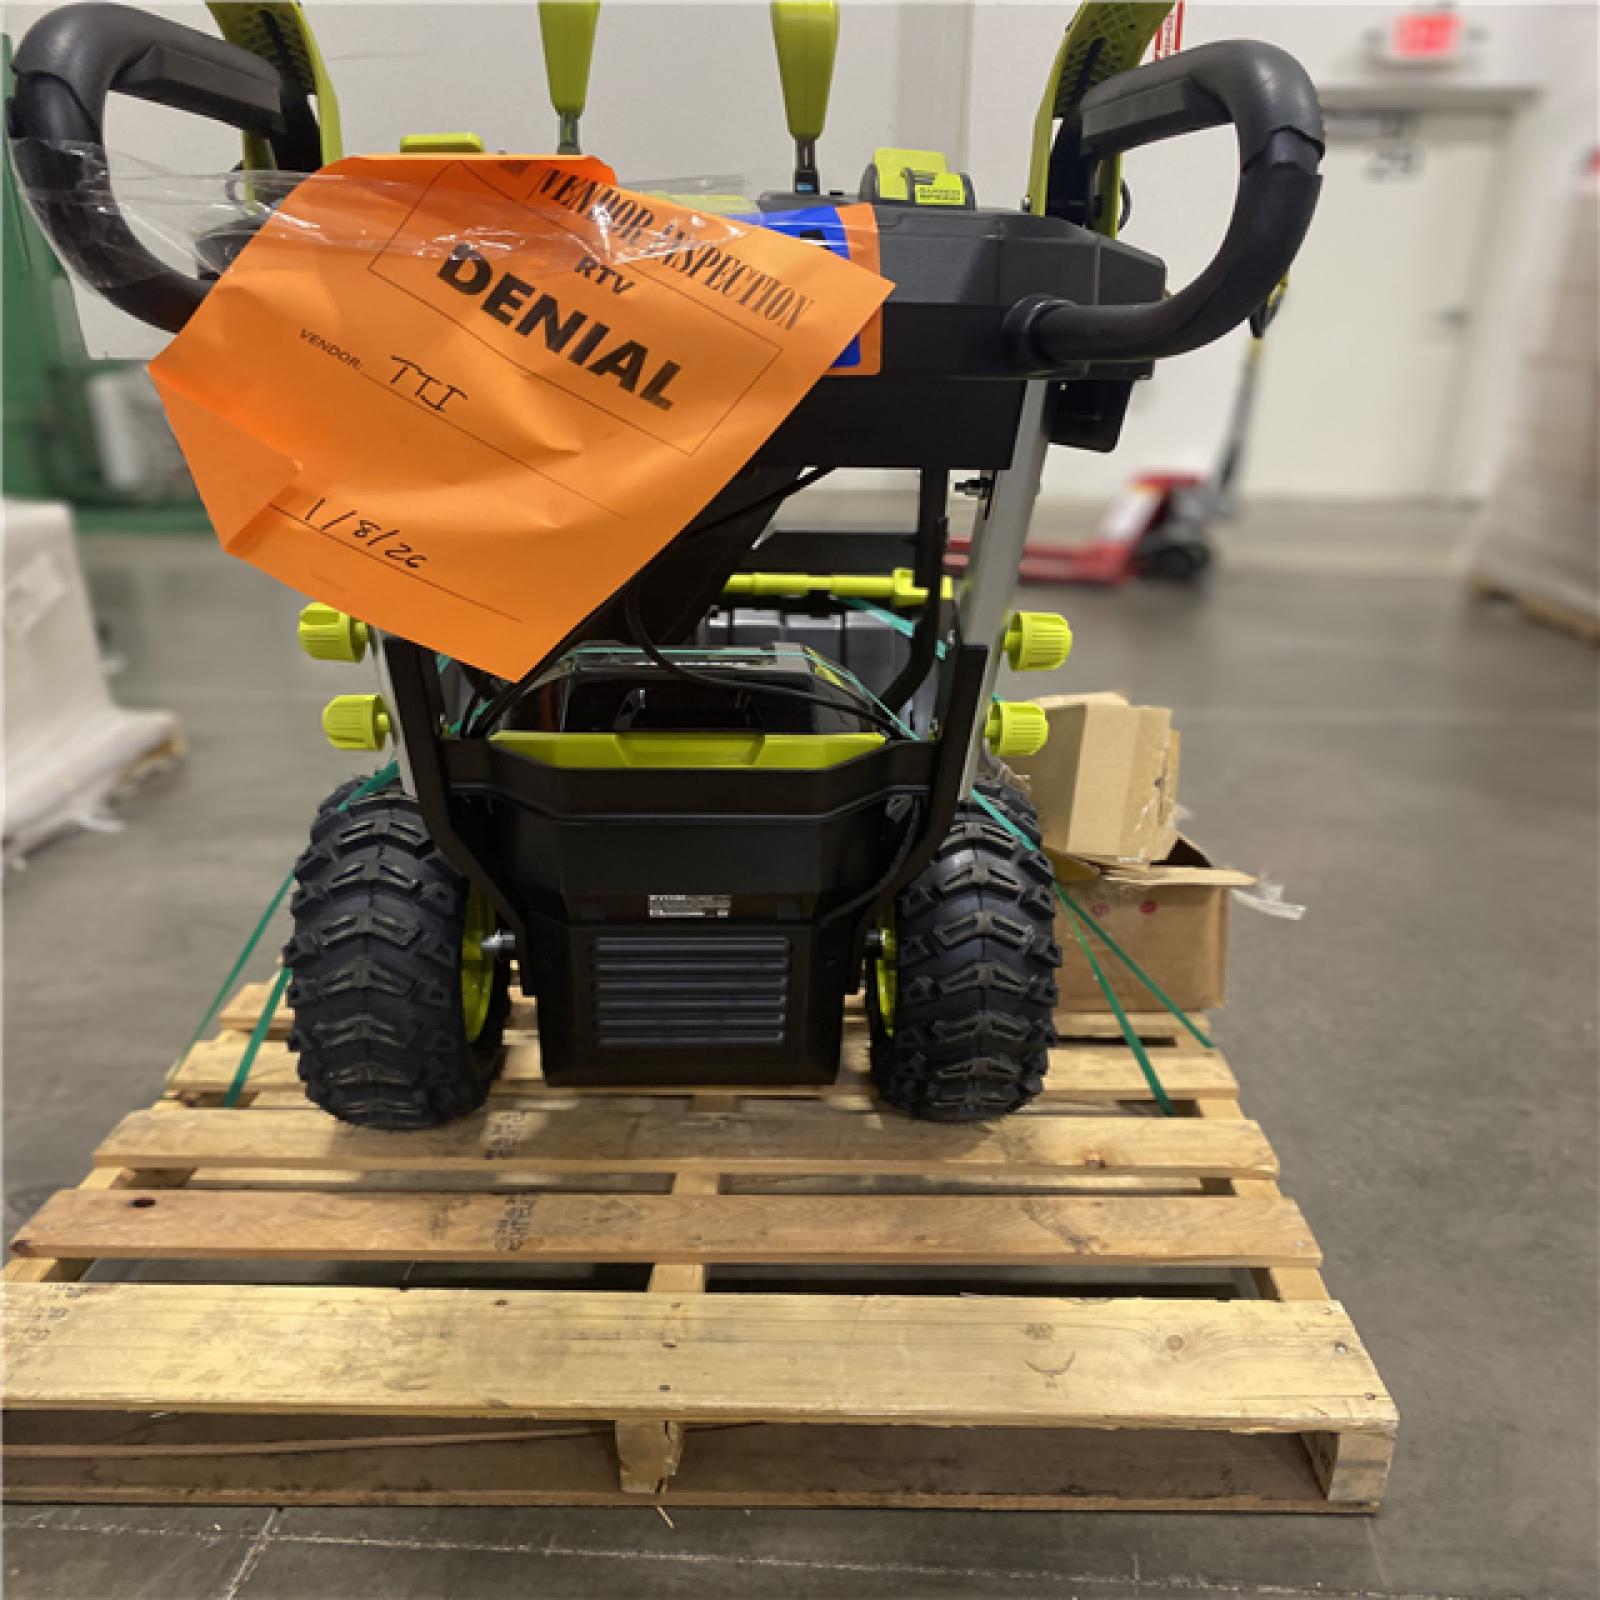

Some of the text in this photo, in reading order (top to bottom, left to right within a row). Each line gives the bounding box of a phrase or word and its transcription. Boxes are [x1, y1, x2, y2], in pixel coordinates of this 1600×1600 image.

[538, 169, 655, 246] VENDOR
[574, 253, 636, 295] RTV
[437, 243, 681, 411] DENIAL
